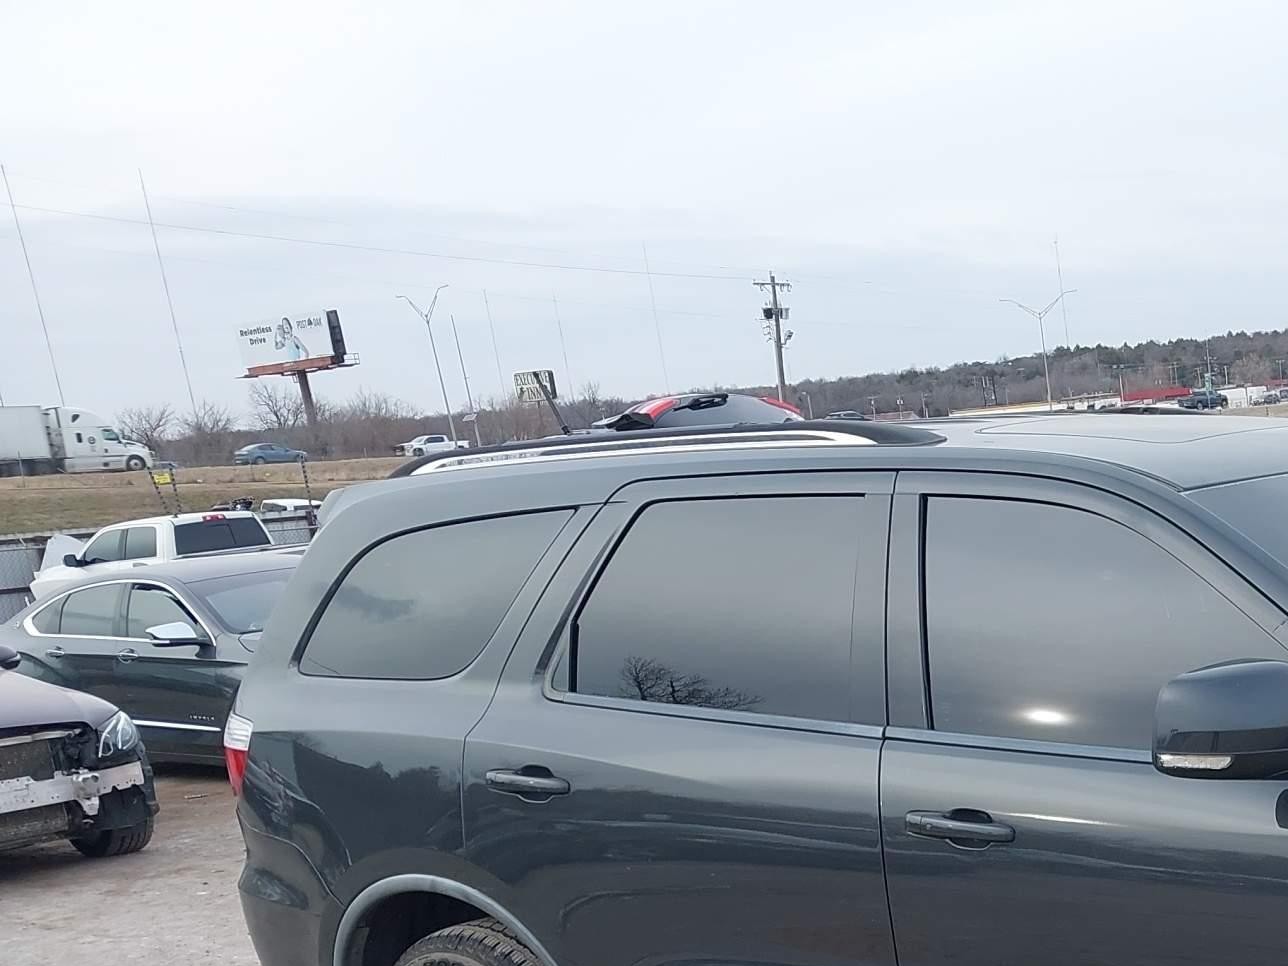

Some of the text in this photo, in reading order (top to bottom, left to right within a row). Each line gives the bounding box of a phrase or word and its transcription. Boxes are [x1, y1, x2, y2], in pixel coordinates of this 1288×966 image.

[239, 326, 272, 337] Relentless
[249, 337, 266, 345] Drive
[514, 371, 549, 386] EXECUVE
